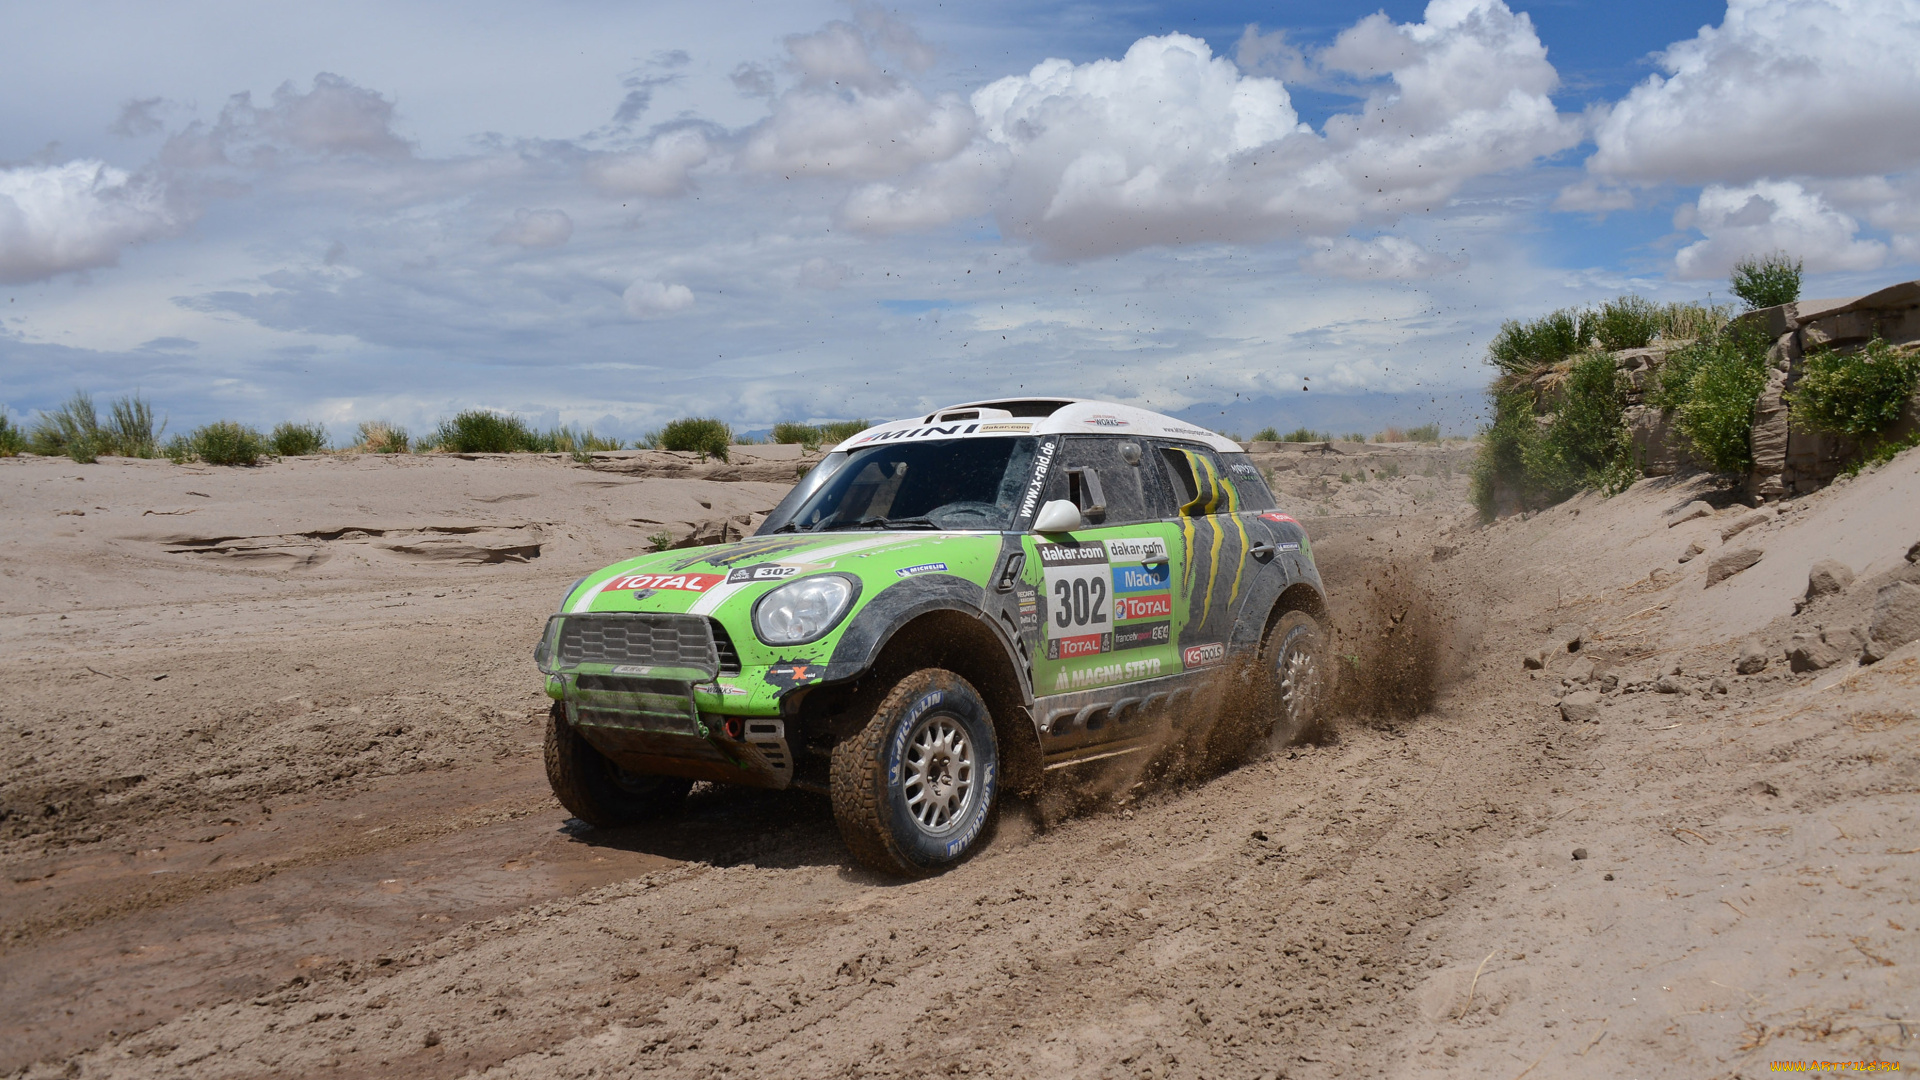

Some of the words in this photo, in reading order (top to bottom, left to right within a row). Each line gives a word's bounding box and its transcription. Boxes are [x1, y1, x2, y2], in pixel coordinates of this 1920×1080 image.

[871, 424, 980, 441] MINI
[1020, 441, 1056, 518] www.x-raid.de
[1042, 545, 1104, 561] dakar.com
[1111, 542, 1164, 556] dakar.com
[761, 568, 796, 576] 302
[909, 564, 945, 573] MICHELIN
[616, 574, 704, 590] TOTAL
[1125, 571, 1160, 588] Macro
[1054, 576, 1107, 628] 302
[1128, 600, 1170, 615] TOTAL
[1062, 640, 1099, 654] TOTAL
[1200, 647, 1221, 661] TOOLS
[1071, 664, 1123, 688] MAGNA
[1125, 658, 1161, 676] STEYR
[706, 686, 733, 694] WORKS
[949, 787, 991, 858] MICHELIN
